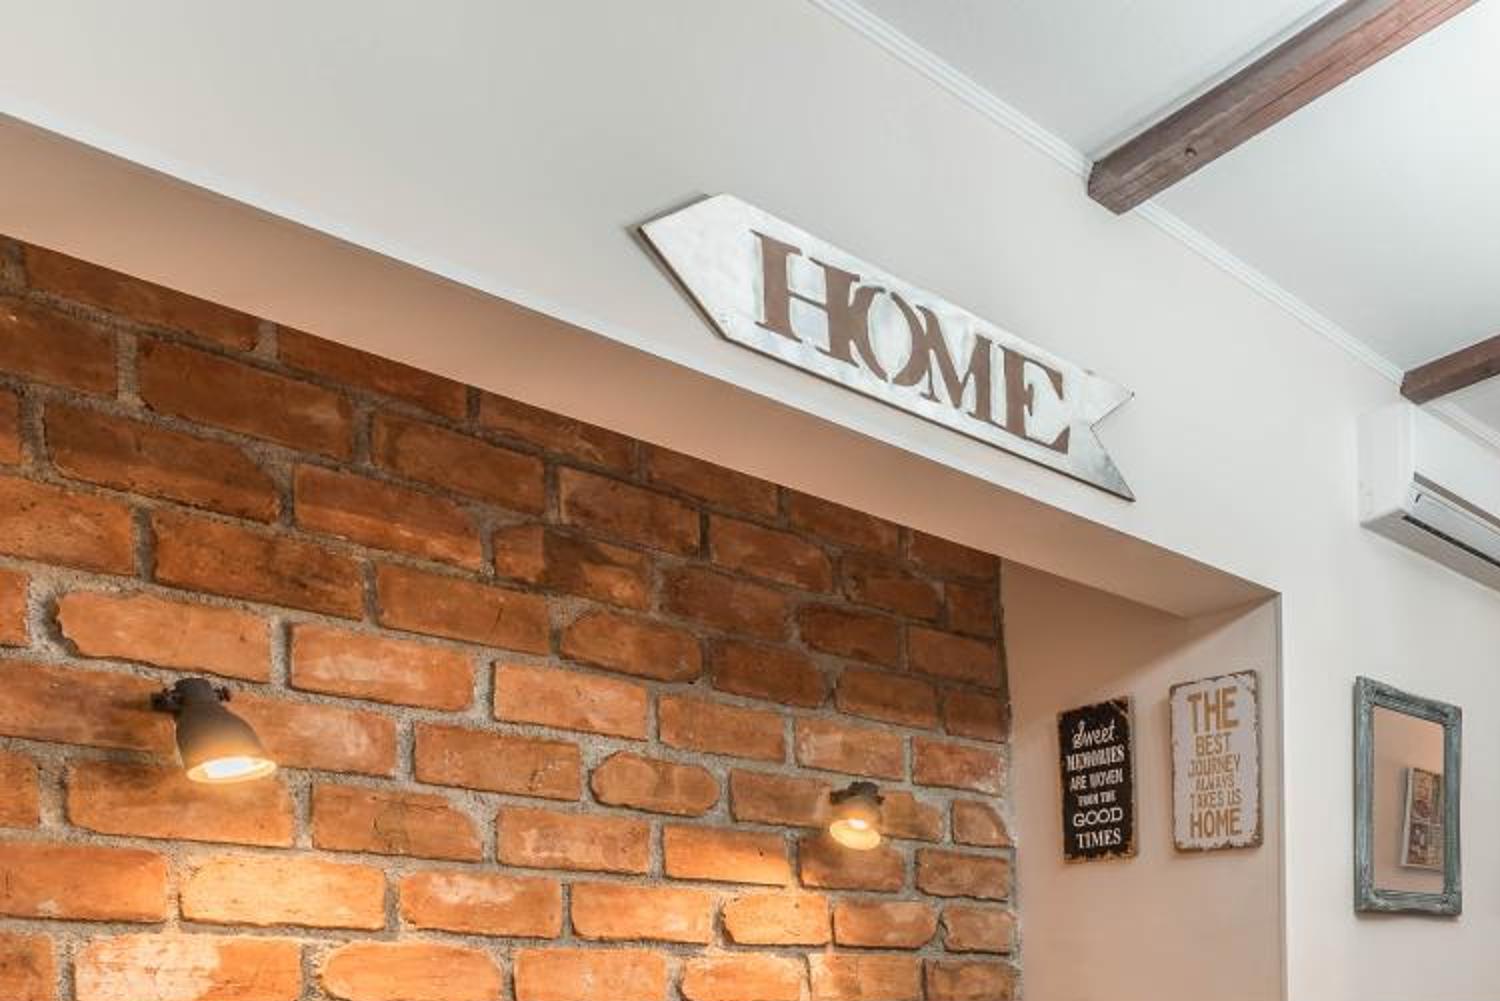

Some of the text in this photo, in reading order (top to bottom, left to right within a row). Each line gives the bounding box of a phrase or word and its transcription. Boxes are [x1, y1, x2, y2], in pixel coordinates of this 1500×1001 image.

[750, 229, 1070, 455] HOME
[1186, 686, 1239, 734] THE
[1072, 719, 1115, 748] Sweet
[1195, 732, 1231, 756] BEST
[1066, 745, 1125, 771] MEMORIES
[1188, 754, 1241, 777] JOURNEY
[1070, 768, 1124, 792] ARE WOVEN
[1195, 773, 1235, 790] ALWAYS
[1190, 788, 1242, 809] TAKES US
[1073, 807, 1123, 827] GOOD
[1190, 808, 1242, 838] HOME
[1076, 828, 1122, 849] TIMES
